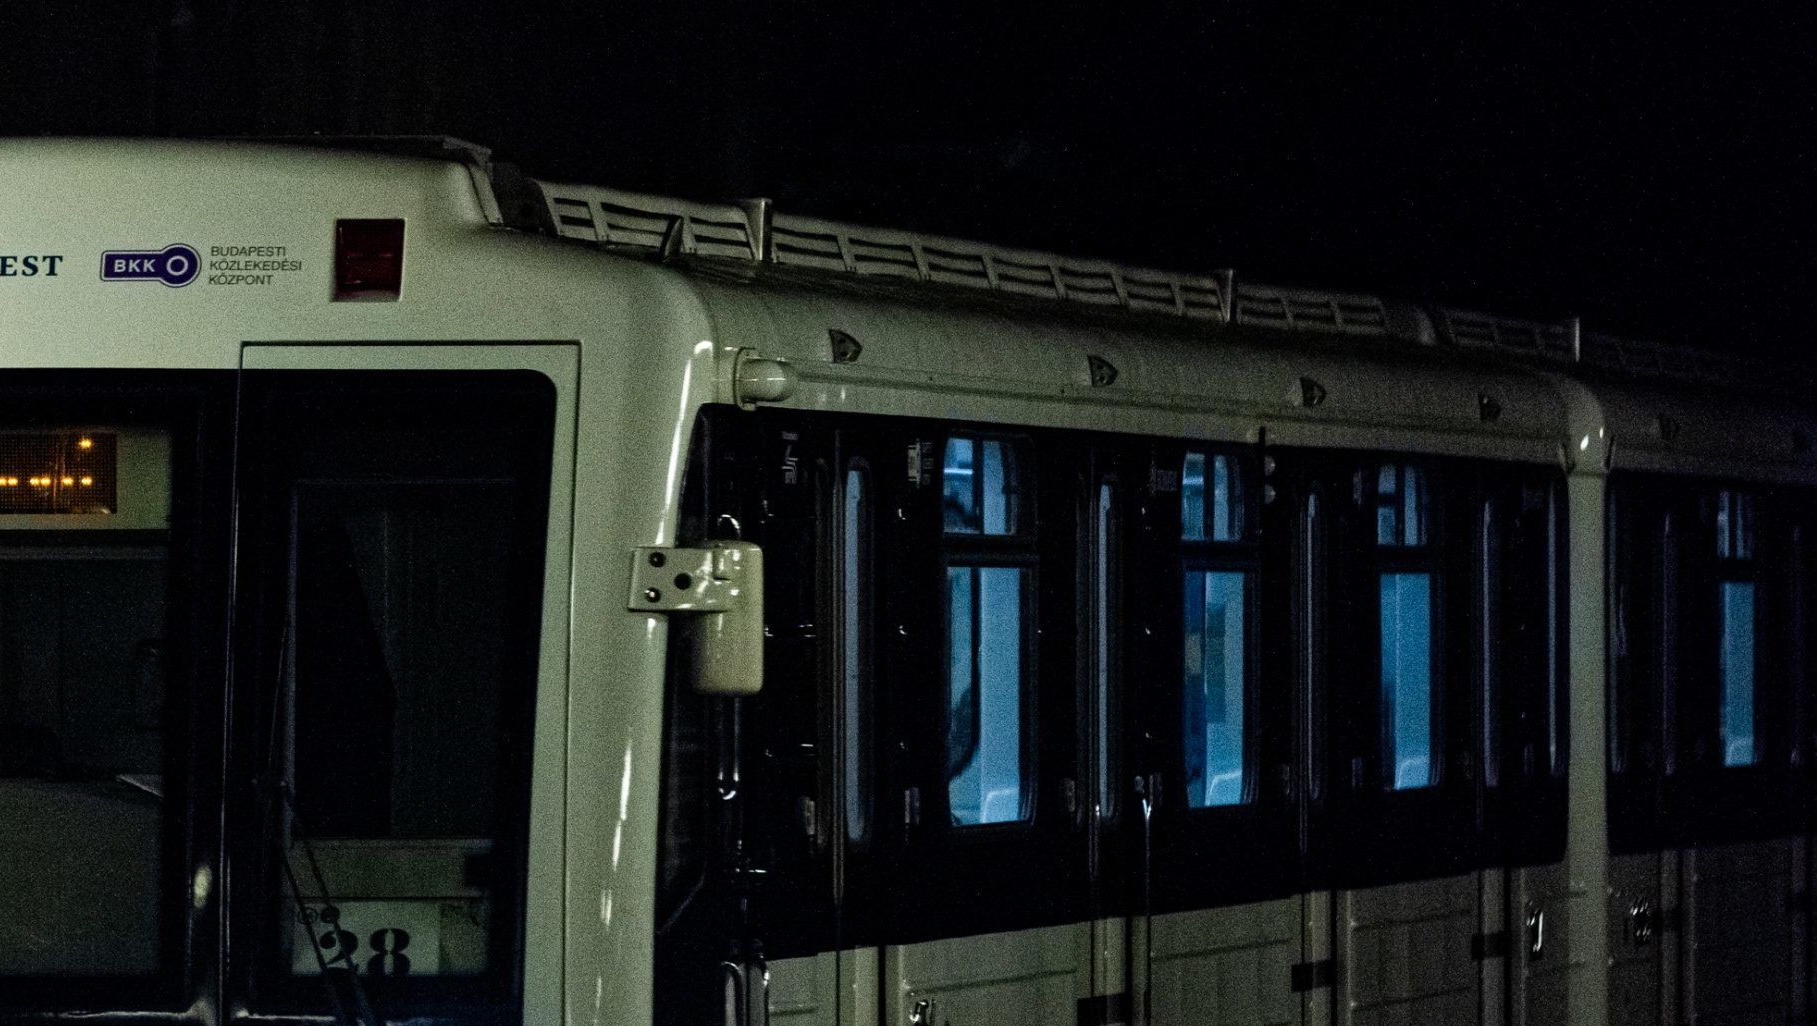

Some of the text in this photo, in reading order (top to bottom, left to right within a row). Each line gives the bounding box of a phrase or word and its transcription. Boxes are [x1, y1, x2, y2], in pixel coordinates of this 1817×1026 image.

[210, 246, 287, 257] BUDAPESTI
[113, 258, 156, 273] BKK
[209, 258, 302, 271] KÖZLEKEDÉSI
[208, 272, 274, 285] KÖZPONT
